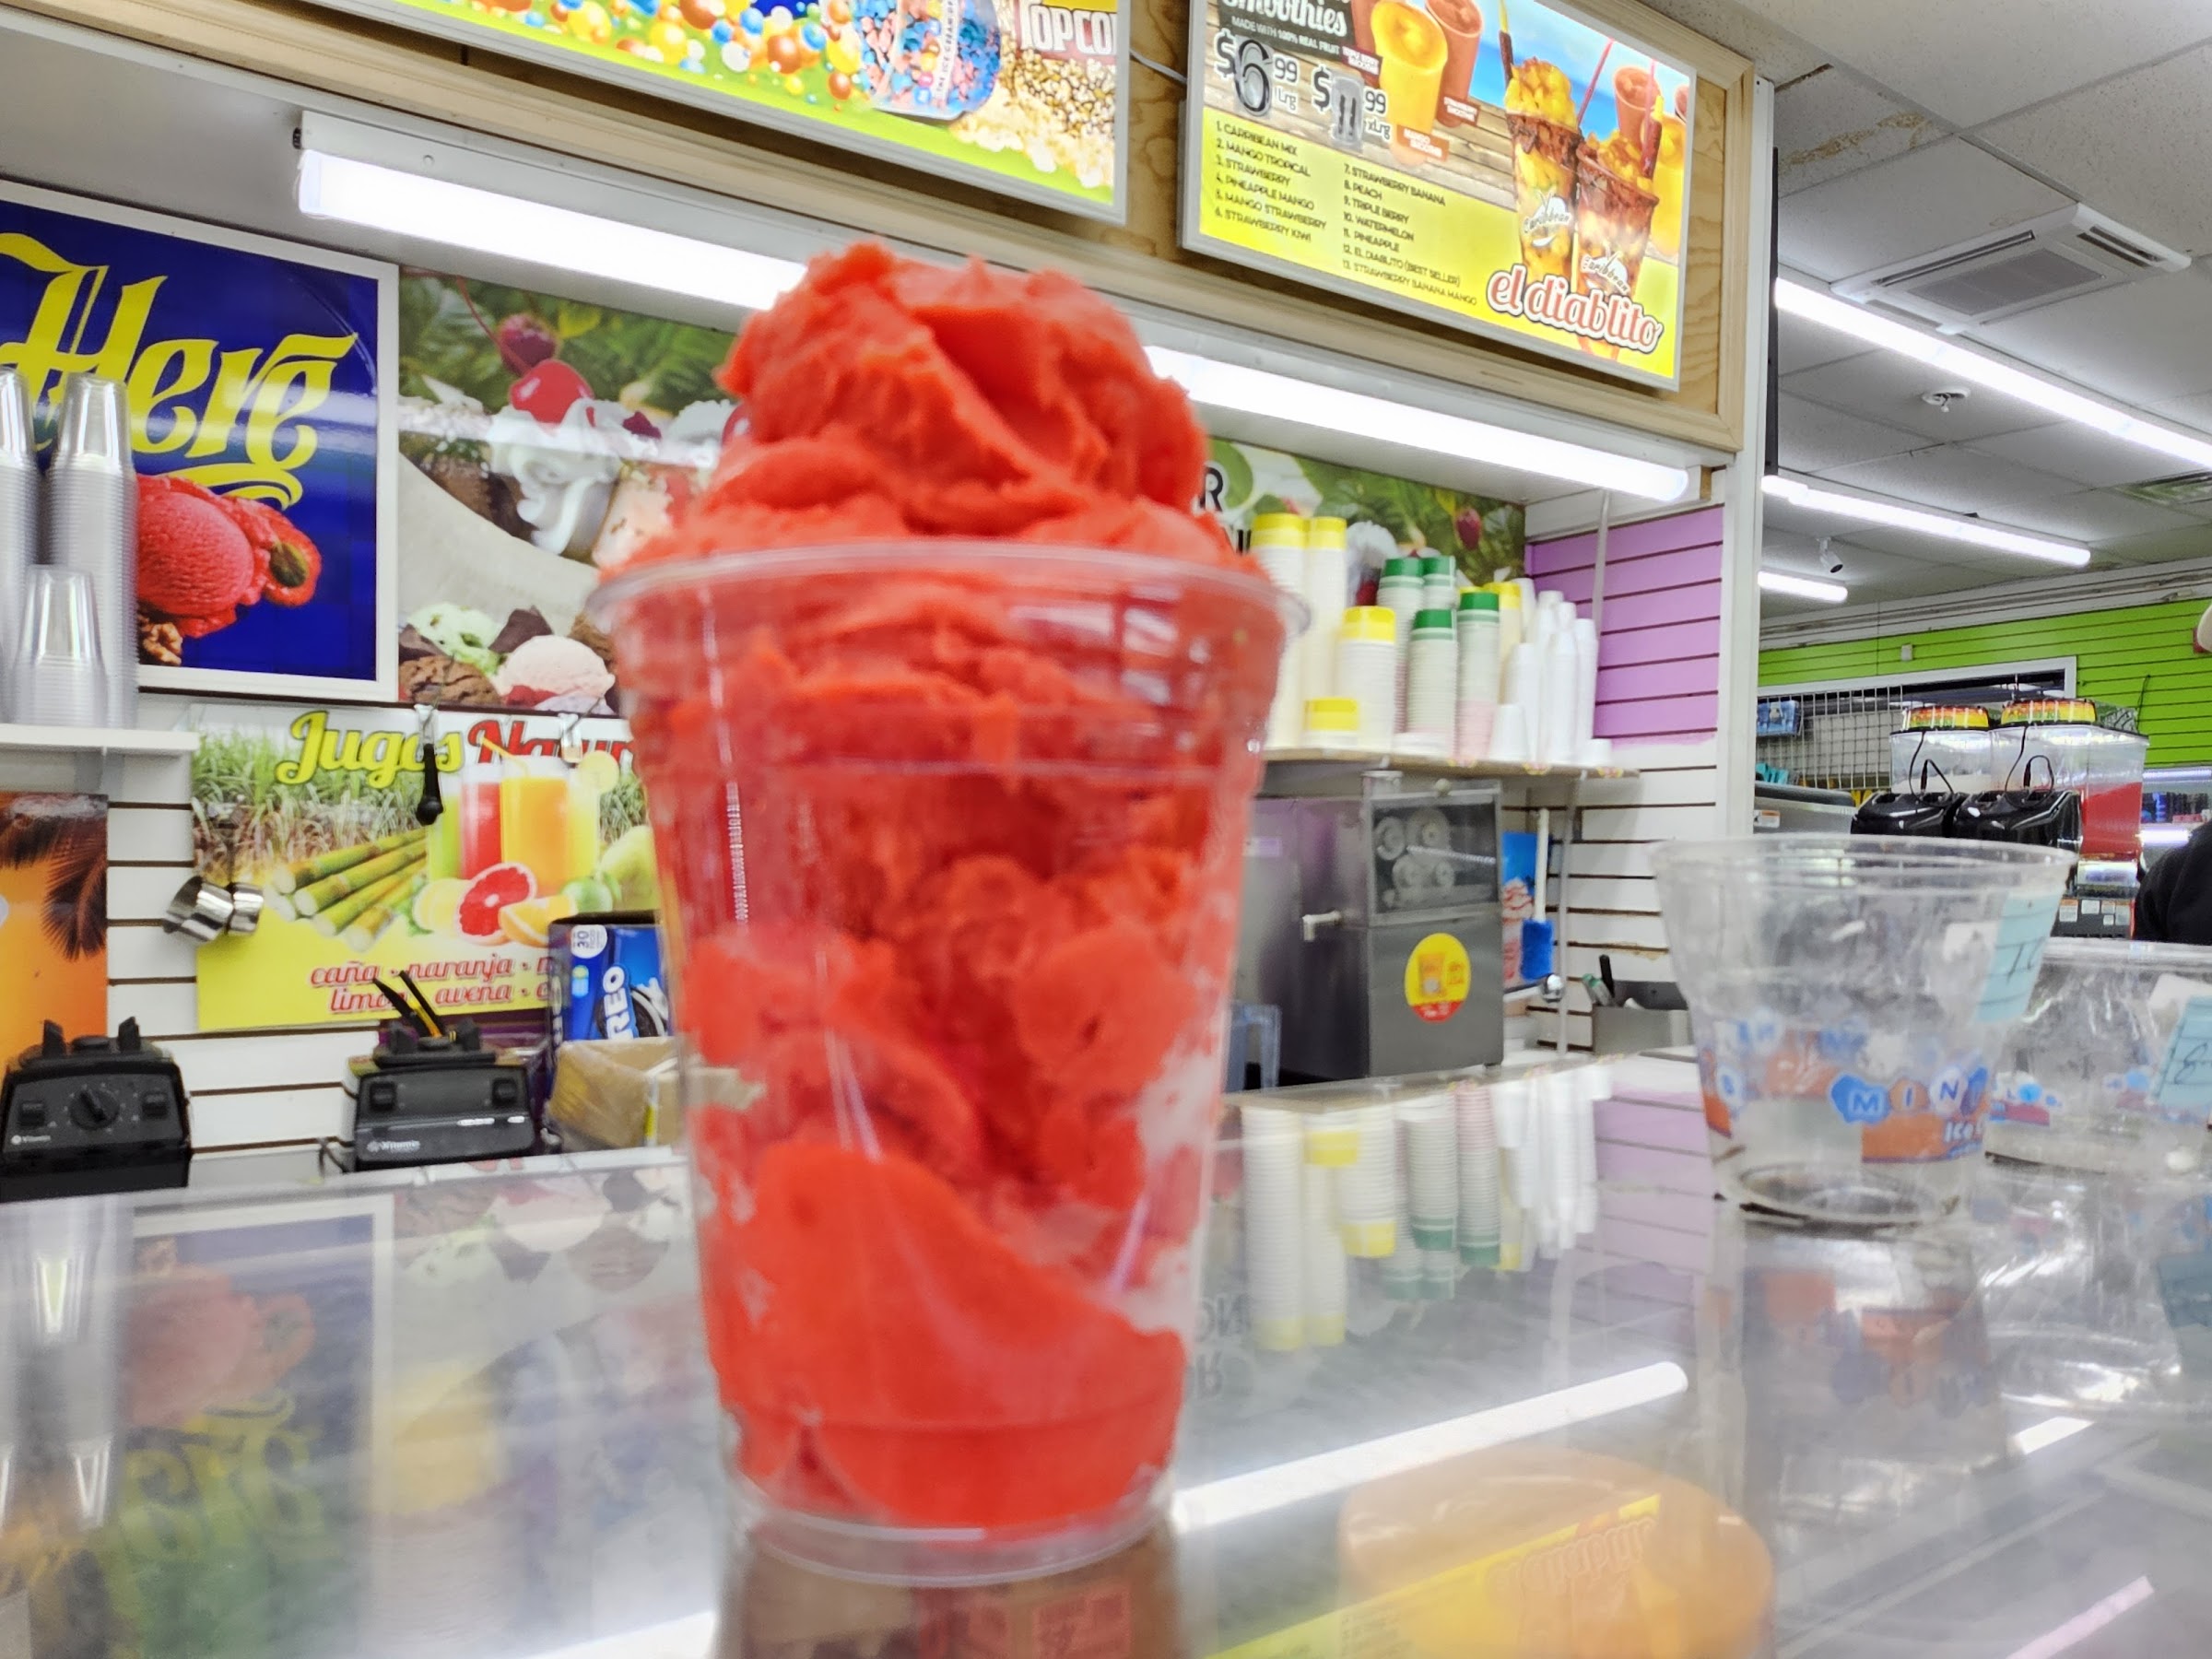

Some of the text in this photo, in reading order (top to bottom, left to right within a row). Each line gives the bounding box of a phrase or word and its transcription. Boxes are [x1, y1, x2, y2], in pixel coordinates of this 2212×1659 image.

[1020, 0, 1117, 54] OPCO
[1231, 16, 1256, 31] MADE
[1256, 23, 1277, 38] WITH
[1299, 35, 1318, 49] REAL
[1226, 159, 1291, 186] STRAWBERRY
[1227, 141, 1264, 161] MANGO
[1265, 153, 1311, 177] TROPICAL
[1226, 175, 1277, 199] PINEAPPLE
[1279, 191, 1314, 210] MANGO
[1352, 167, 1409, 194] STRAWBERRY
[1410, 186, 1446, 206] BANANA
[1353, 182, 1382, 200] PEACH
[1225, 193, 1263, 212] MANGO
[1265, 204, 1327, 229] STRAWBERRY
[1225, 209, 1289, 236] STRAWBERRY
[1291, 228, 1312, 242] KIWI
[1352, 198, 1381, 216] TRIPLE
[1382, 208, 1409, 224] BERRY
[1354, 231, 1400, 253] PINEAPPLE
[1356, 216, 1415, 241] WATERMELON
[1354, 262, 1411, 286] STRAWBERRY
[1412, 278, 1446, 297] BANANA
[1447, 288, 1477, 306] MANGO
[1489, 266, 1662, 351] el diablito
[310, 959, 379, 986] caña
[406, 953, 513, 982] naranja
[329, 986, 408, 1013] lim
[434, 983, 513, 1006] avena
[603, 966, 634, 1040] REO
